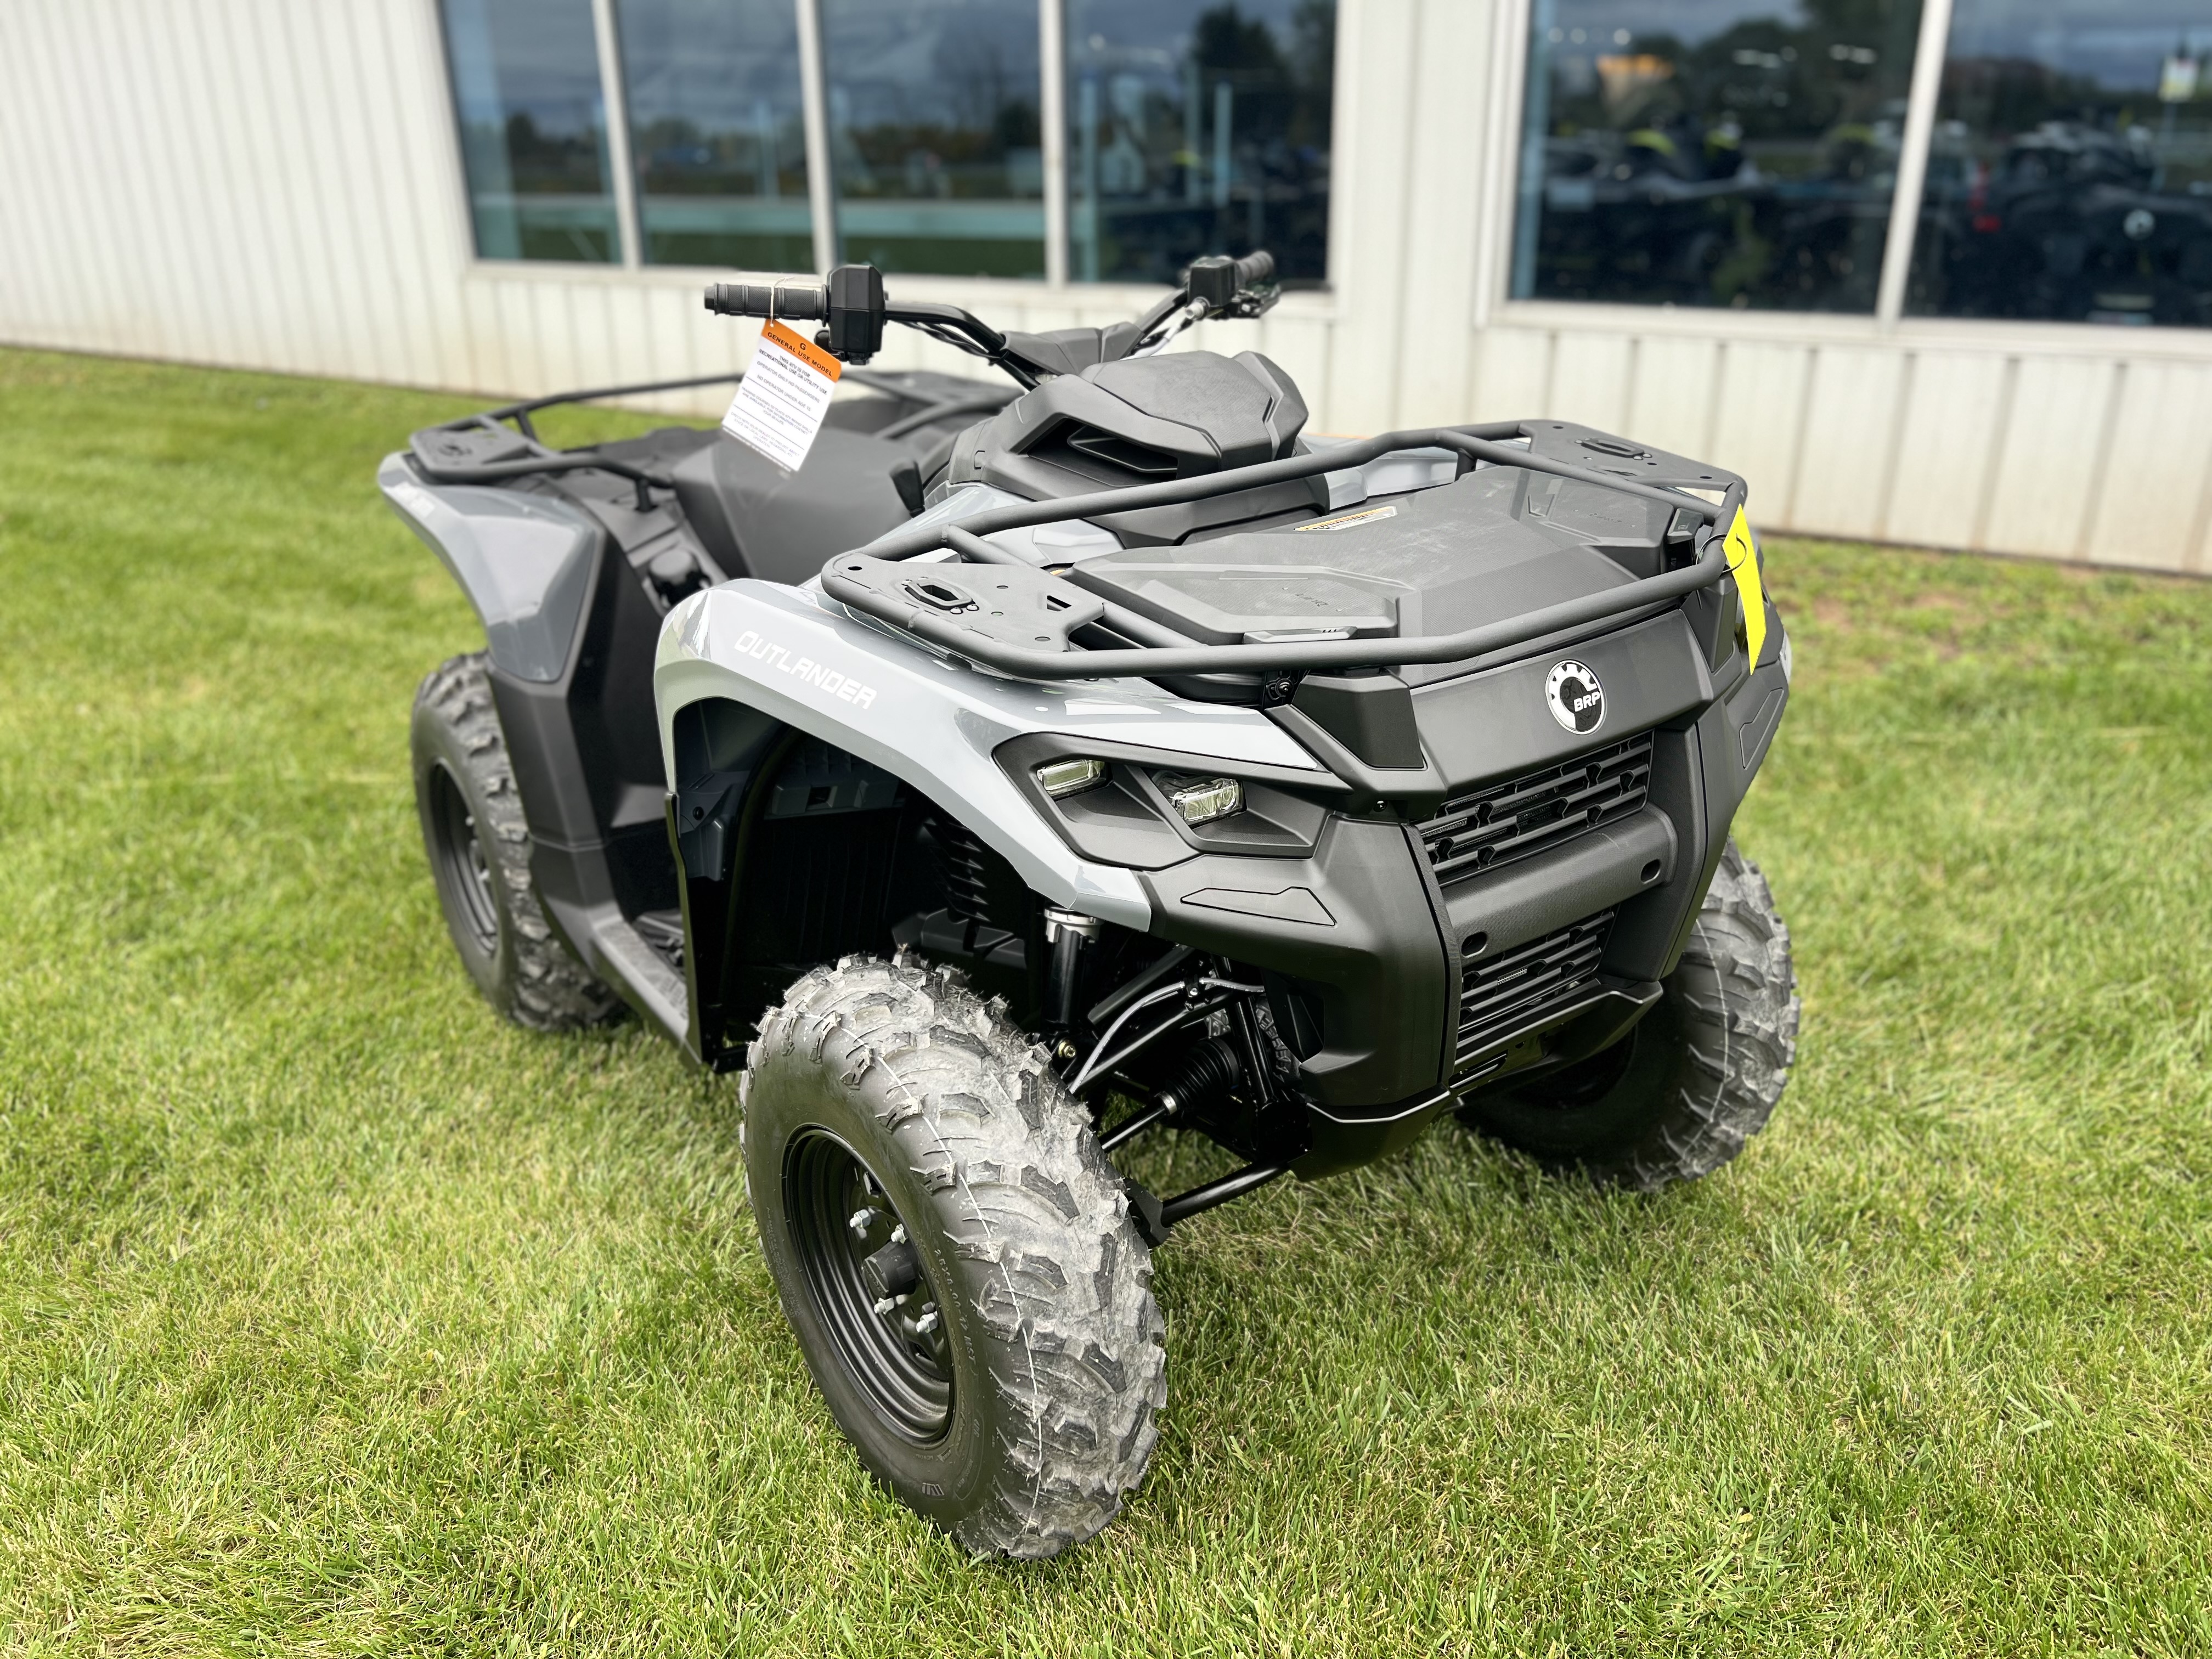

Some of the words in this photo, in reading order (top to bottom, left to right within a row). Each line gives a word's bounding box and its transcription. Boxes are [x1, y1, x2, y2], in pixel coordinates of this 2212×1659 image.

[766, 331, 797, 353] GENERAL
[797, 351, 811, 362] USE
[810, 359, 834, 377] MODEL
[798, 342, 808, 351] G
[756, 360, 778, 376] OPERATOR
[794, 384, 821, 403] PASSENGERS
[758, 348, 789, 370] RECREATIONAL
[788, 367, 797, 375] USE
[803, 376, 820, 390] UTILITY
[818, 387, 828, 395] USE
[778, 355, 789, 364] THIS
[788, 362, 797, 370] ATV
[800, 369, 811, 378] FOR
[763, 378, 784, 394] OPERATOR
[783, 391, 798, 403] UNDER
[797, 400, 806, 408] AGE
[734, 630, 878, 710] OUTLANDER
[1573, 690, 1601, 712] BRP
